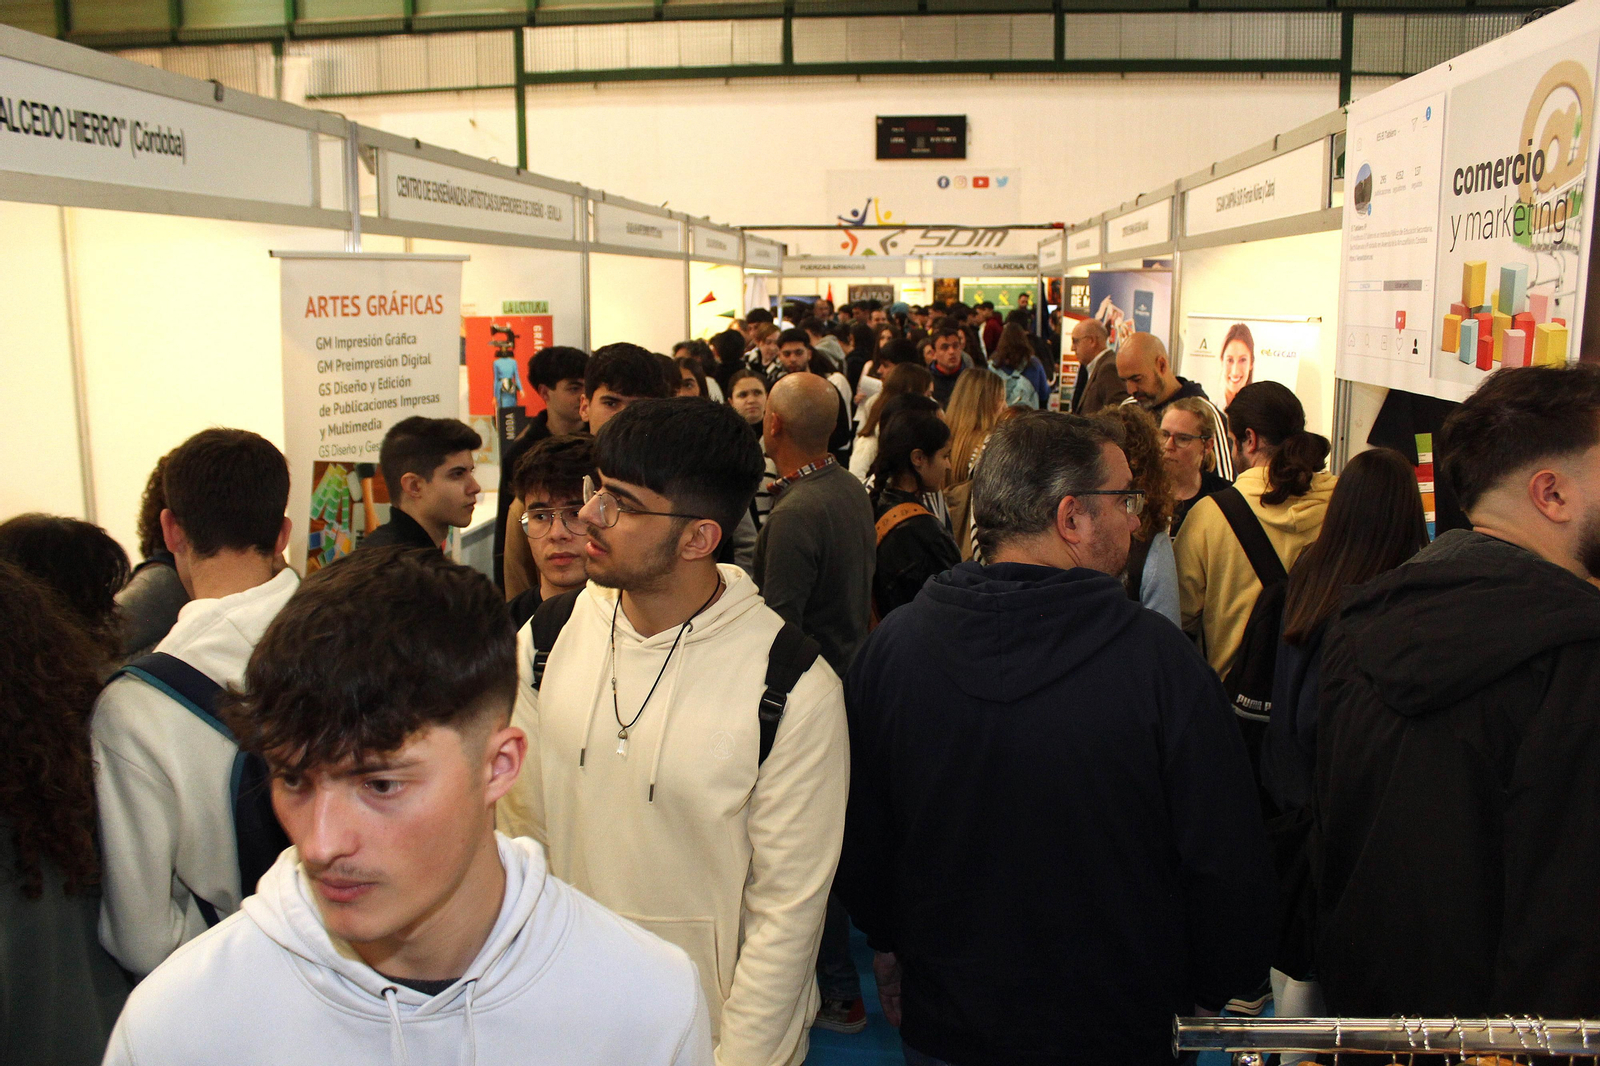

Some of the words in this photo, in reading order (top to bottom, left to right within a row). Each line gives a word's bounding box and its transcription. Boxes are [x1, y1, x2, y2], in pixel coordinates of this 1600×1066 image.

[130, 119, 186, 165] (Córdoba)
[1453, 139, 1545, 196] comercio
[1450, 214, 1461, 253] y
[1465, 192, 1568, 244] marketing
[305, 293, 361, 319] ARTES
[366, 290, 444, 316] GRÁFICAS
[503, 302, 513, 314] LA
[316, 336, 332, 350] GM
[335, 333, 382, 351] Impresión
[385, 332, 417, 347] Gráfica
[317, 359, 333, 374] GM
[335, 355, 398, 373] Preimpresión
[401, 352, 431, 369] Digital
[318, 383, 331, 397] GS
[333, 377, 367, 395] Diseño
[369, 381, 376, 393] y
[378, 375, 411, 390] Edición
[319, 403, 331, 417] de
[333, 397, 397, 415] Publicaciones
[400, 393, 440, 410] Impresas
[319, 426, 325, 441] y
[328, 418, 382, 437] Multimedia
[505, 412, 515, 440] MODA
[318, 445, 330, 458] GS
[331, 440, 357, 456] Diseño
[358, 443, 365, 455] y
[1236, 693, 1263, 711] PUMA
